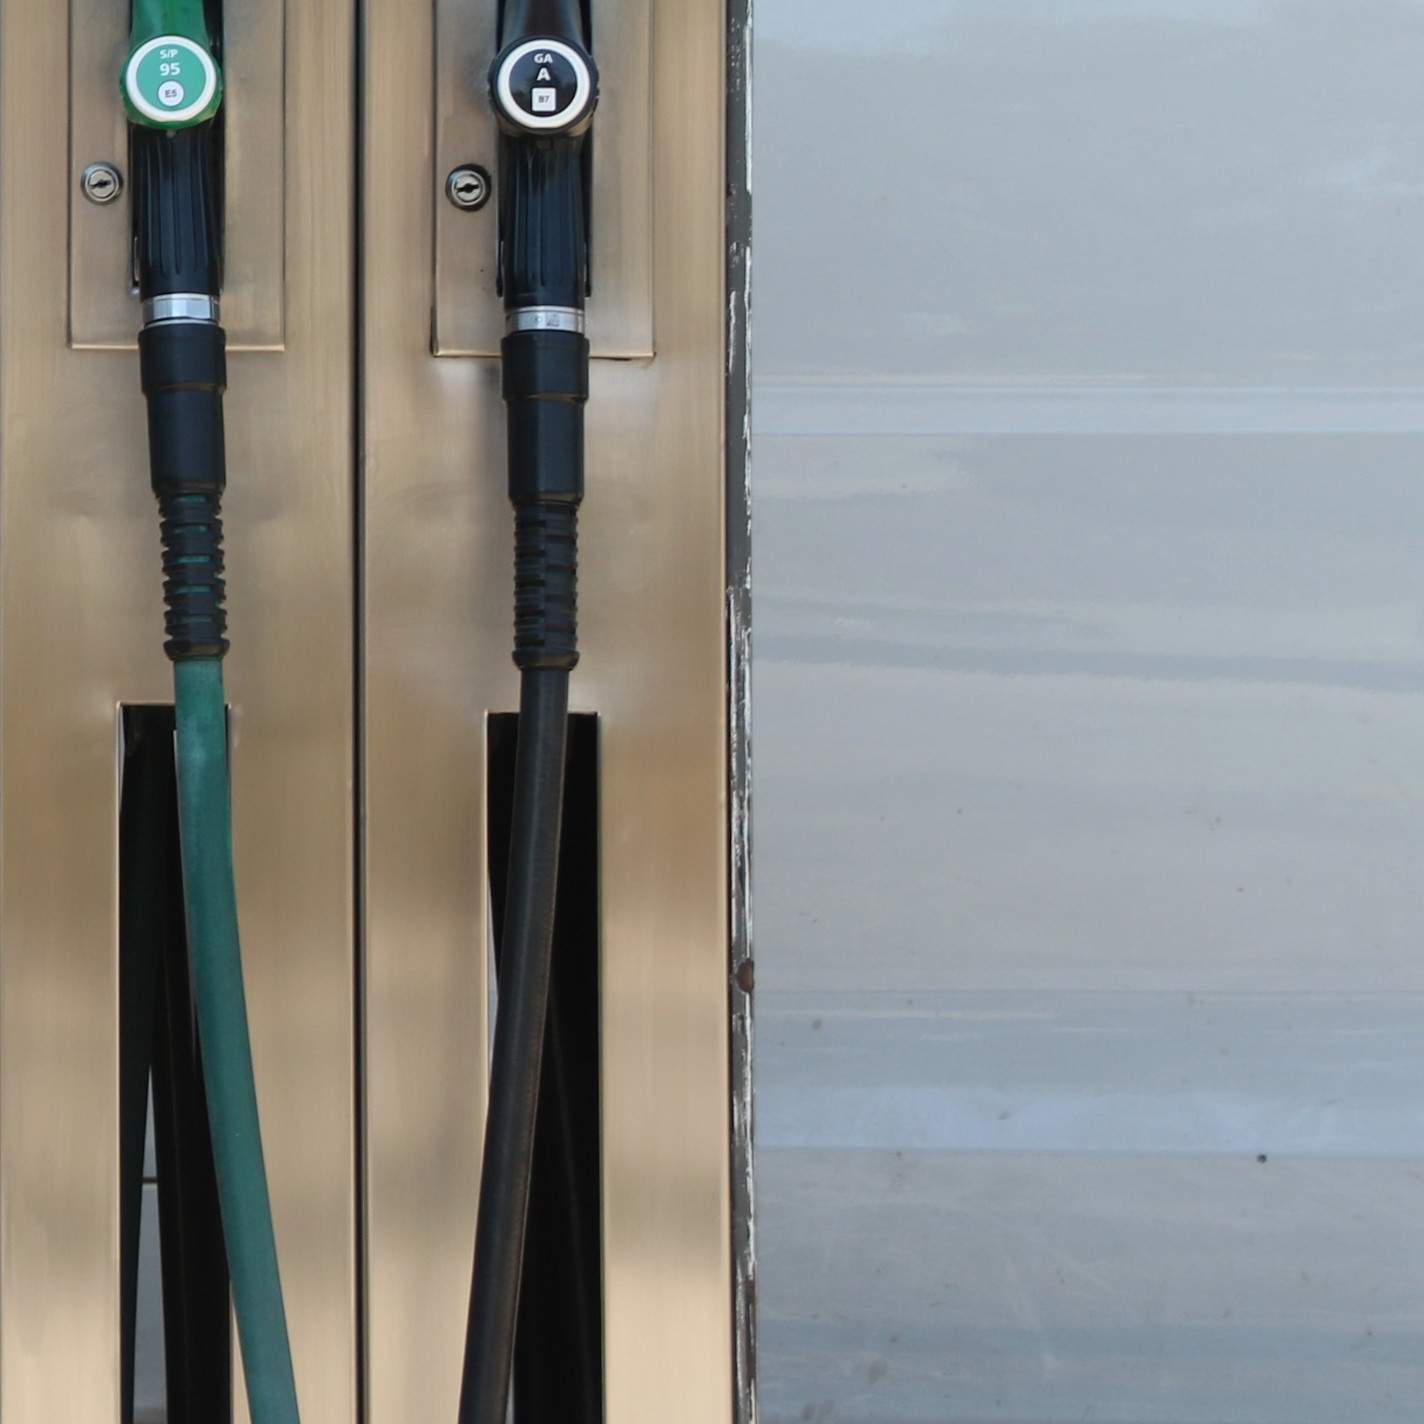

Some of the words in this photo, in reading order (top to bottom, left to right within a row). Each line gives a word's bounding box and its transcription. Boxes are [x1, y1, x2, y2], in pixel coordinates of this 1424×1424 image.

[534, 53, 554, 63] GA
[159, 62, 181, 76] 95
[536, 67, 551, 81] A
